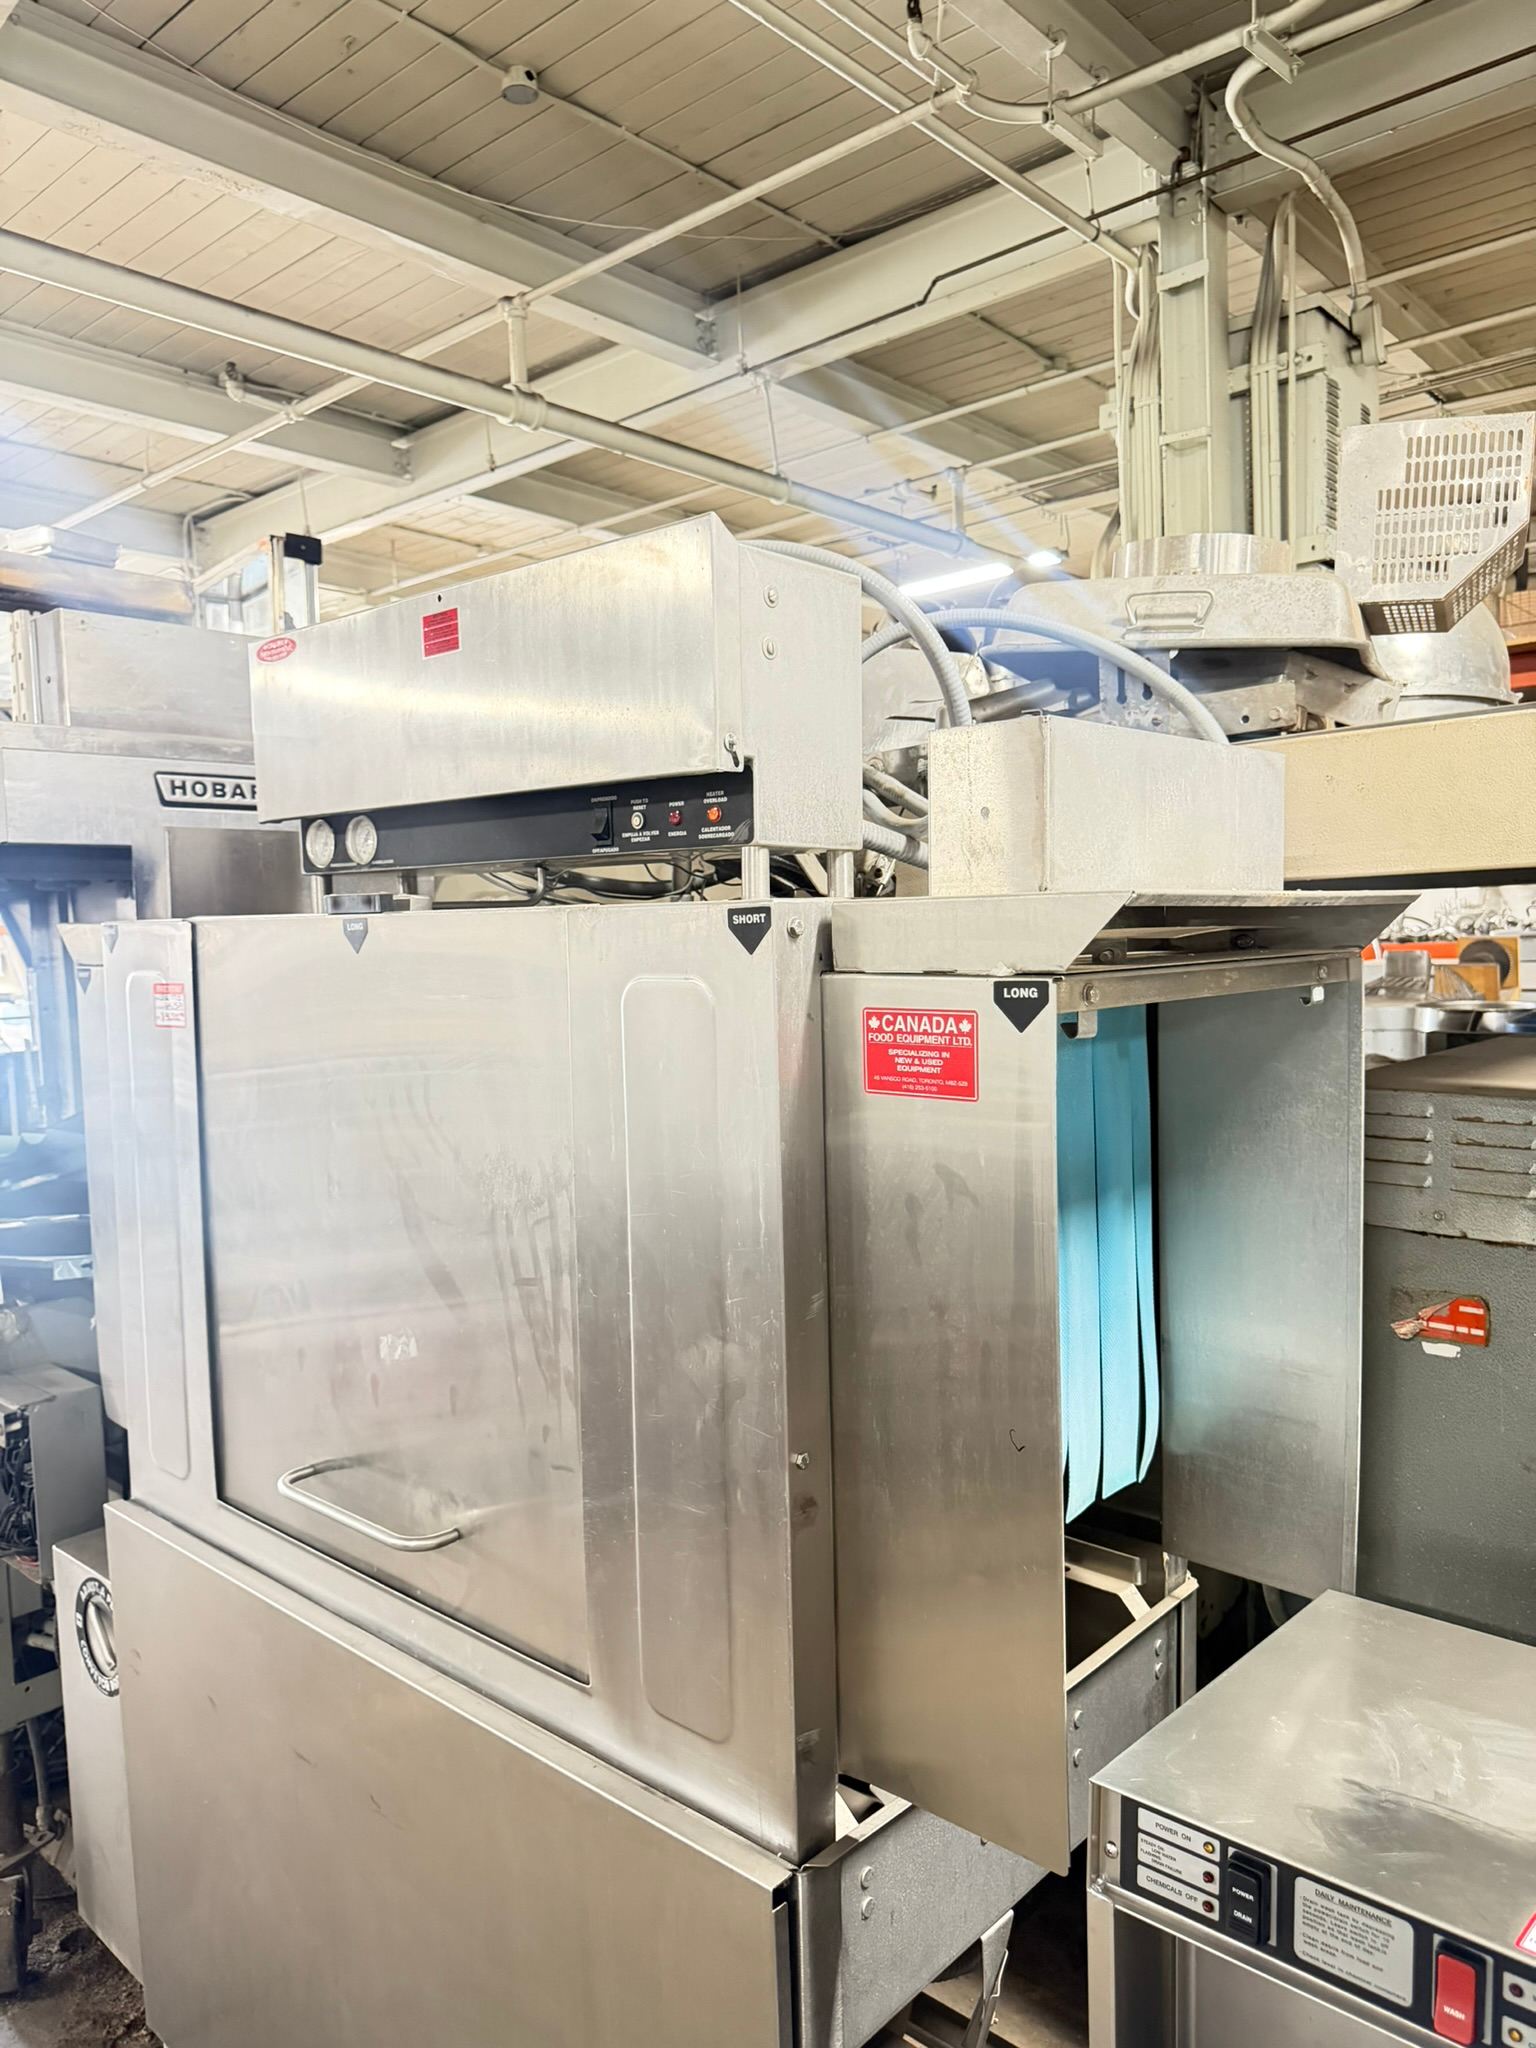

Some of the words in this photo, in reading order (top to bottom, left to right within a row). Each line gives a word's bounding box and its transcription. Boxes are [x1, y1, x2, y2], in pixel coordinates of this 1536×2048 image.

[703, 796, 728, 804] OVERLOAD
[732, 913, 767, 925] SHORT
[1003, 987, 1039, 999] LONG
[882, 1014, 958, 1034] CANADA
[868, 1032, 894, 1043] FOOD
[896, 1034, 951, 1045] EQUIPMENT
[952, 1036, 973, 1046] LTD.
[888, 1049, 940, 1058] SPECIALIZING
[941, 1051, 951, 1059] IN
[894, 1057, 913, 1065] NEW
[913, 1058, 920, 1066] &
[921, 1059, 944, 1067] USED
[896, 1065, 942, 1074] EQUIPMENT
[1155, 1822, 1178, 1837] POWER
[1181, 1833, 1191, 1842] ON
[1146, 1875, 1183, 1896] CHEMICALS
[1185, 1893, 1198, 1902] OFF
[1232, 1886, 1255, 1901] POWER
[1315, 1888, 1335, 1903] DAILY
[1338, 1898, 1392, 1928] MAINTENANCE
[1233, 1910, 1253, 1924] DRAIN
[1443, 2005, 1465, 2021] WASH
